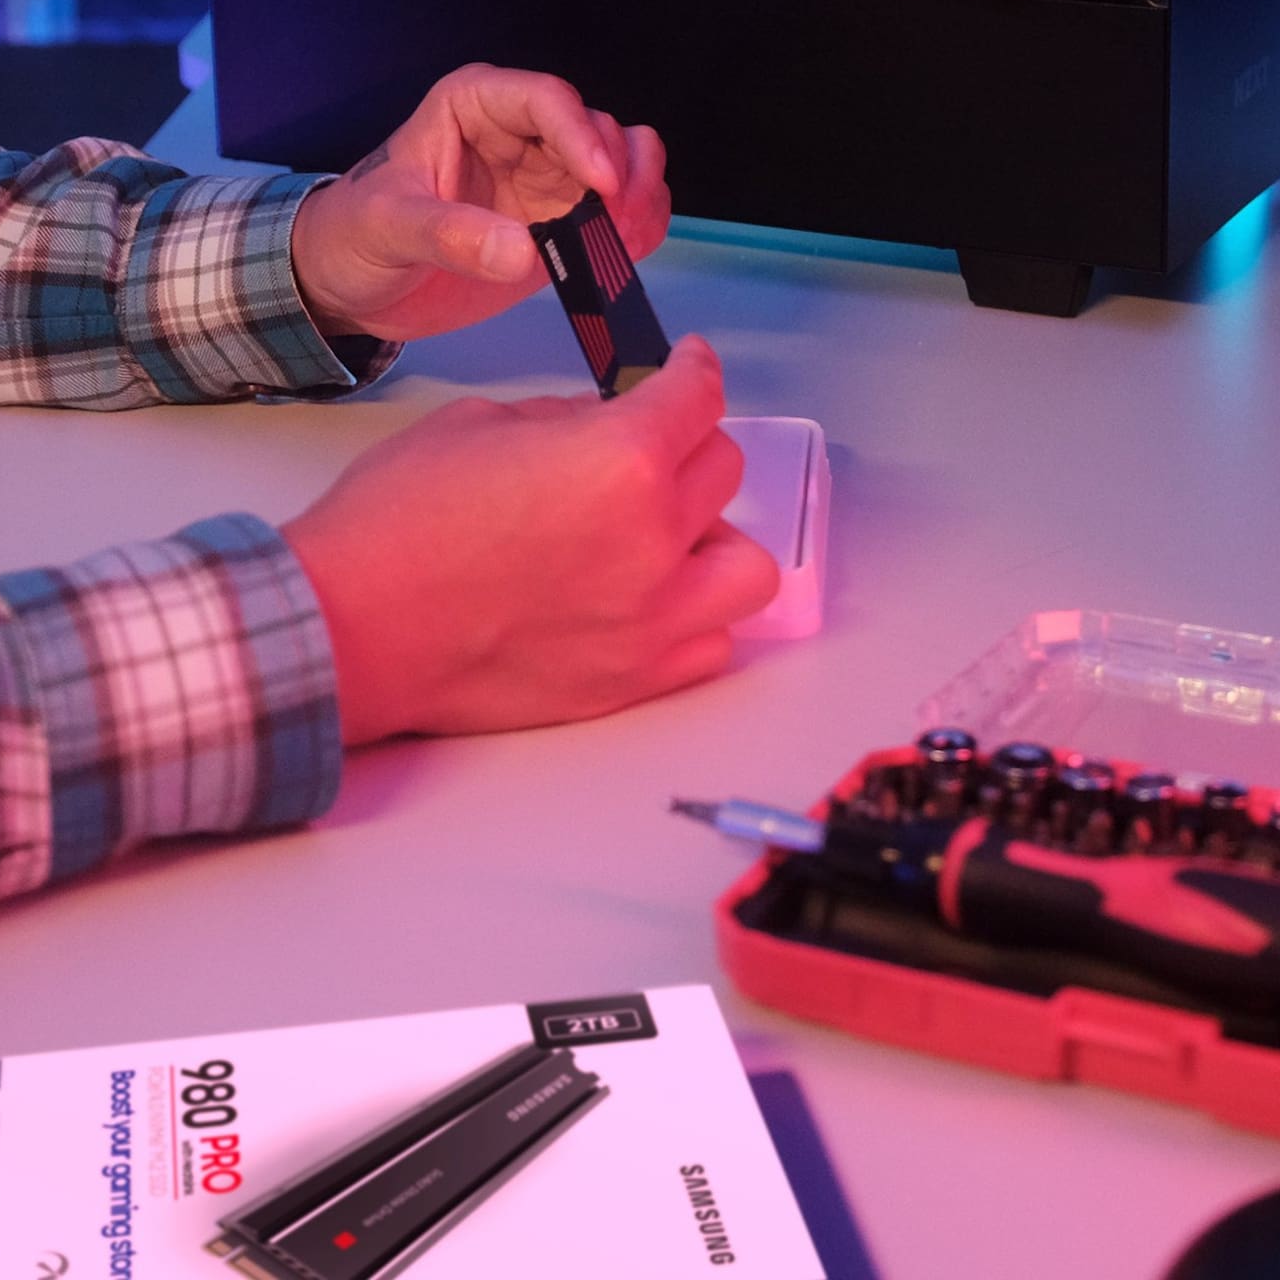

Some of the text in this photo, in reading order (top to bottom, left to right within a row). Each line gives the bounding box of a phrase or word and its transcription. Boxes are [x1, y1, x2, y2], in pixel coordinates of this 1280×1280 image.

[545, 239, 568, 281] SAMSUNG
[566, 1014, 619, 1034] 2TB
[181, 1059, 243, 1195] 980 PRO
[506, 1074, 572, 1122] SAMSUNG
[101, 1070, 139, 1280] Boost your gaming stor
[679, 1164, 736, 1265] SAMSUNG
